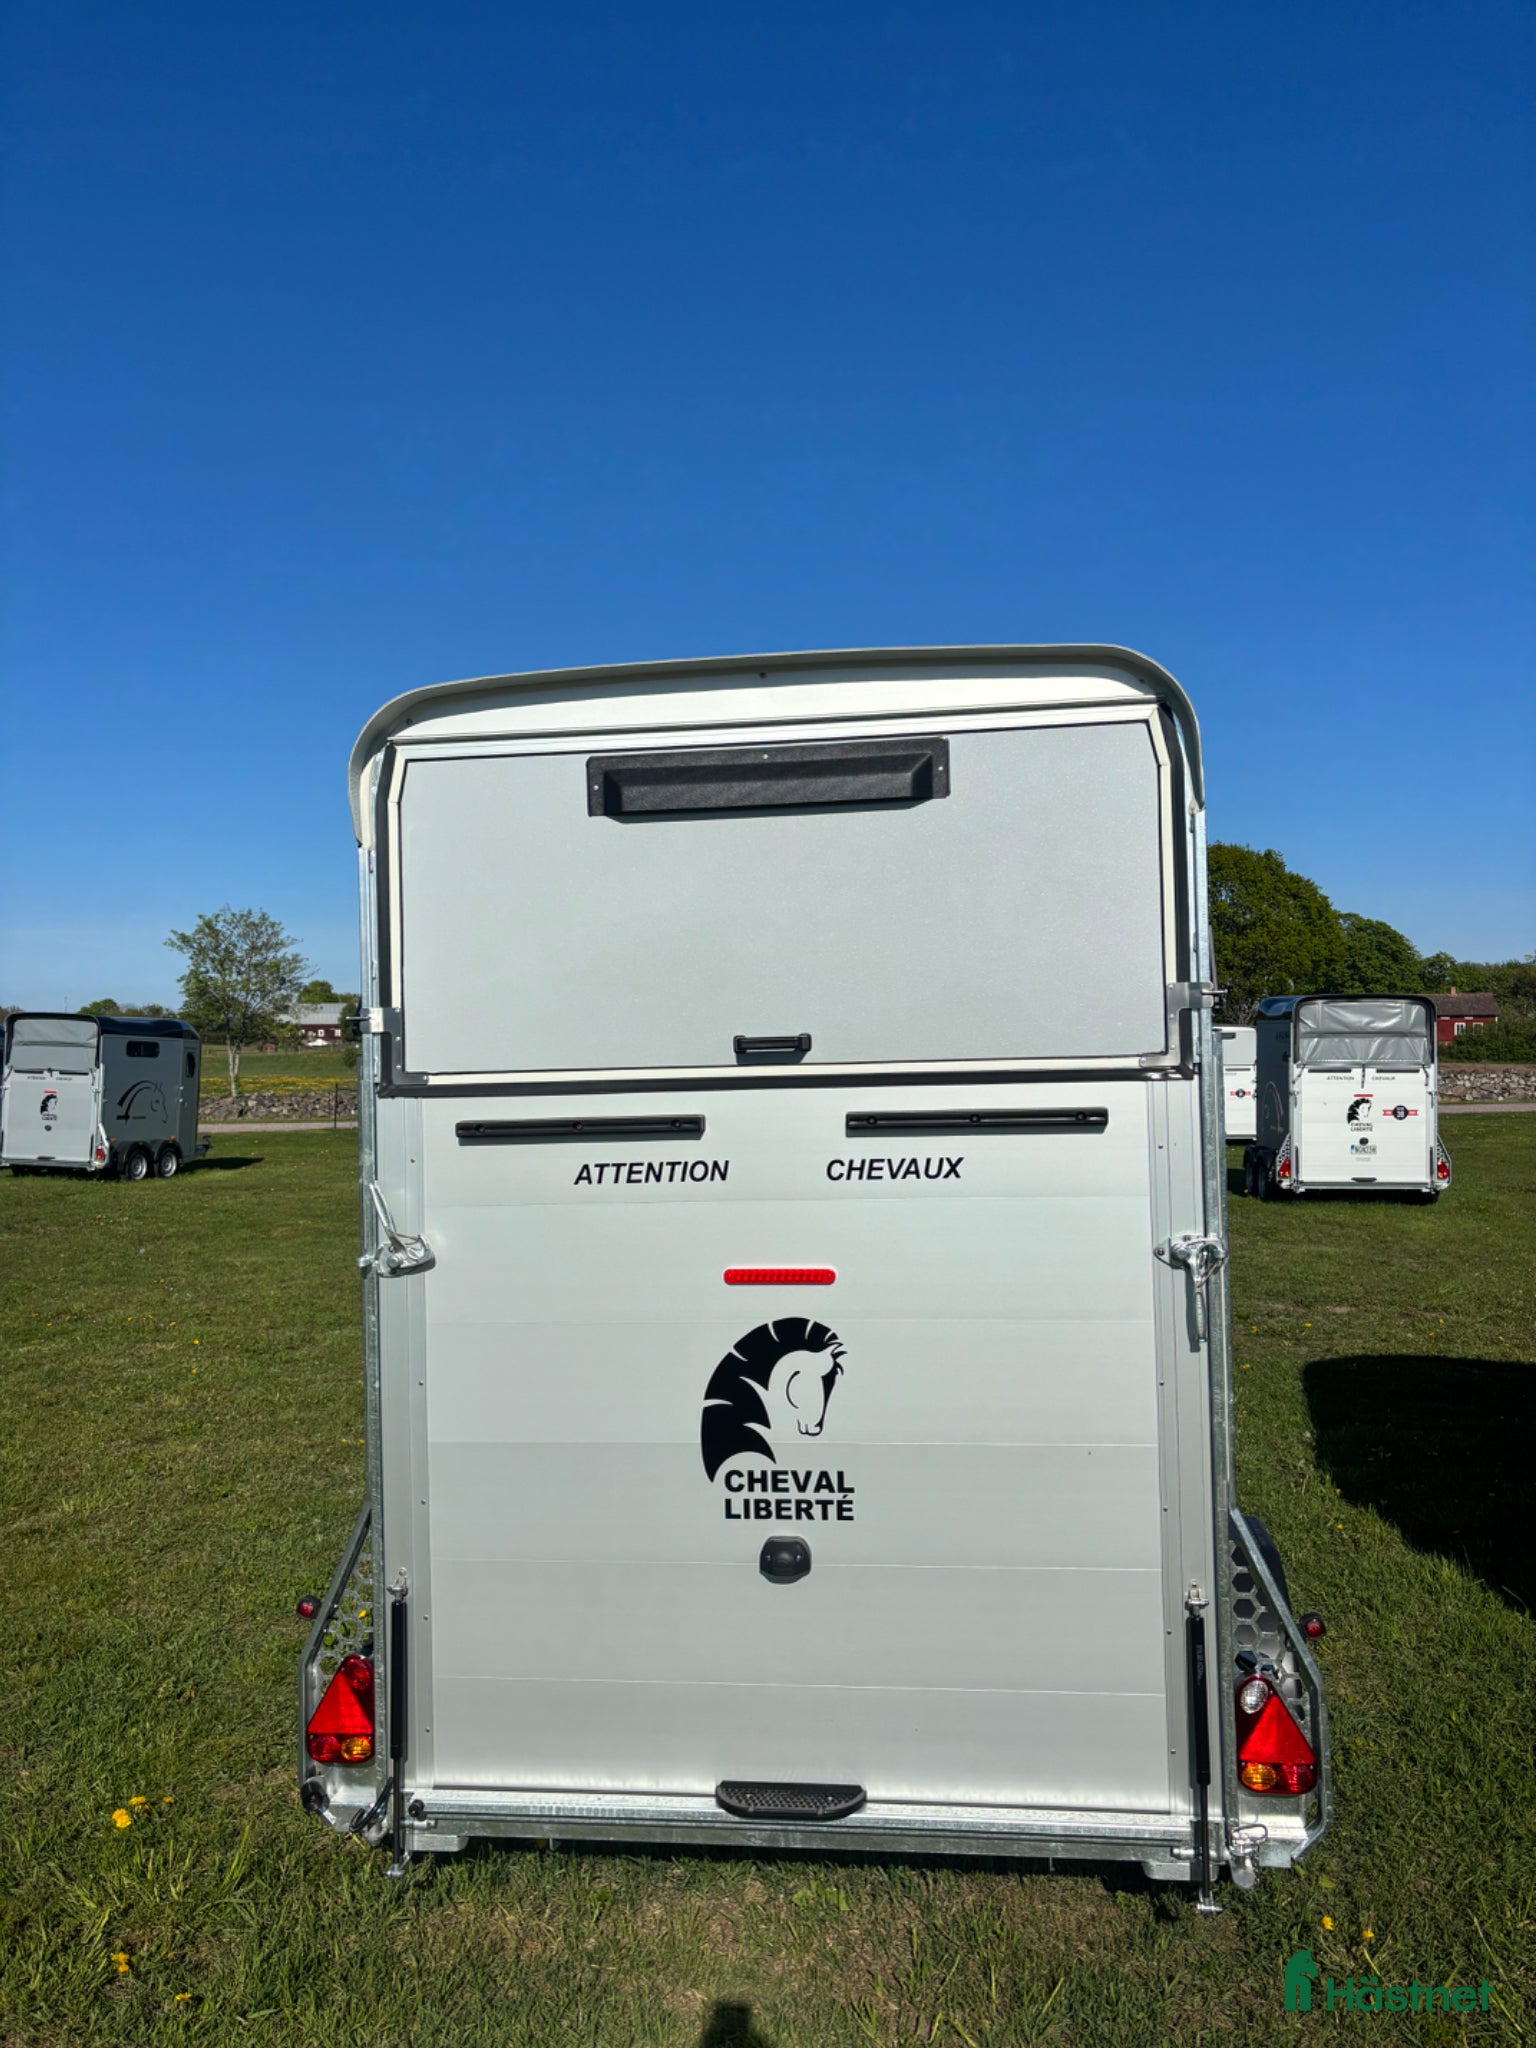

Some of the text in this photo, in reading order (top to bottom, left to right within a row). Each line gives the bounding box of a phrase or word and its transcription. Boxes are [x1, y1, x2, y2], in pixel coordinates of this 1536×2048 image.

[573, 1157, 964, 1186] ATTENTION CHEVAUX
[724, 1469, 855, 1494] CHEVAL
[724, 1494, 855, 1521] LIBERTÉ
